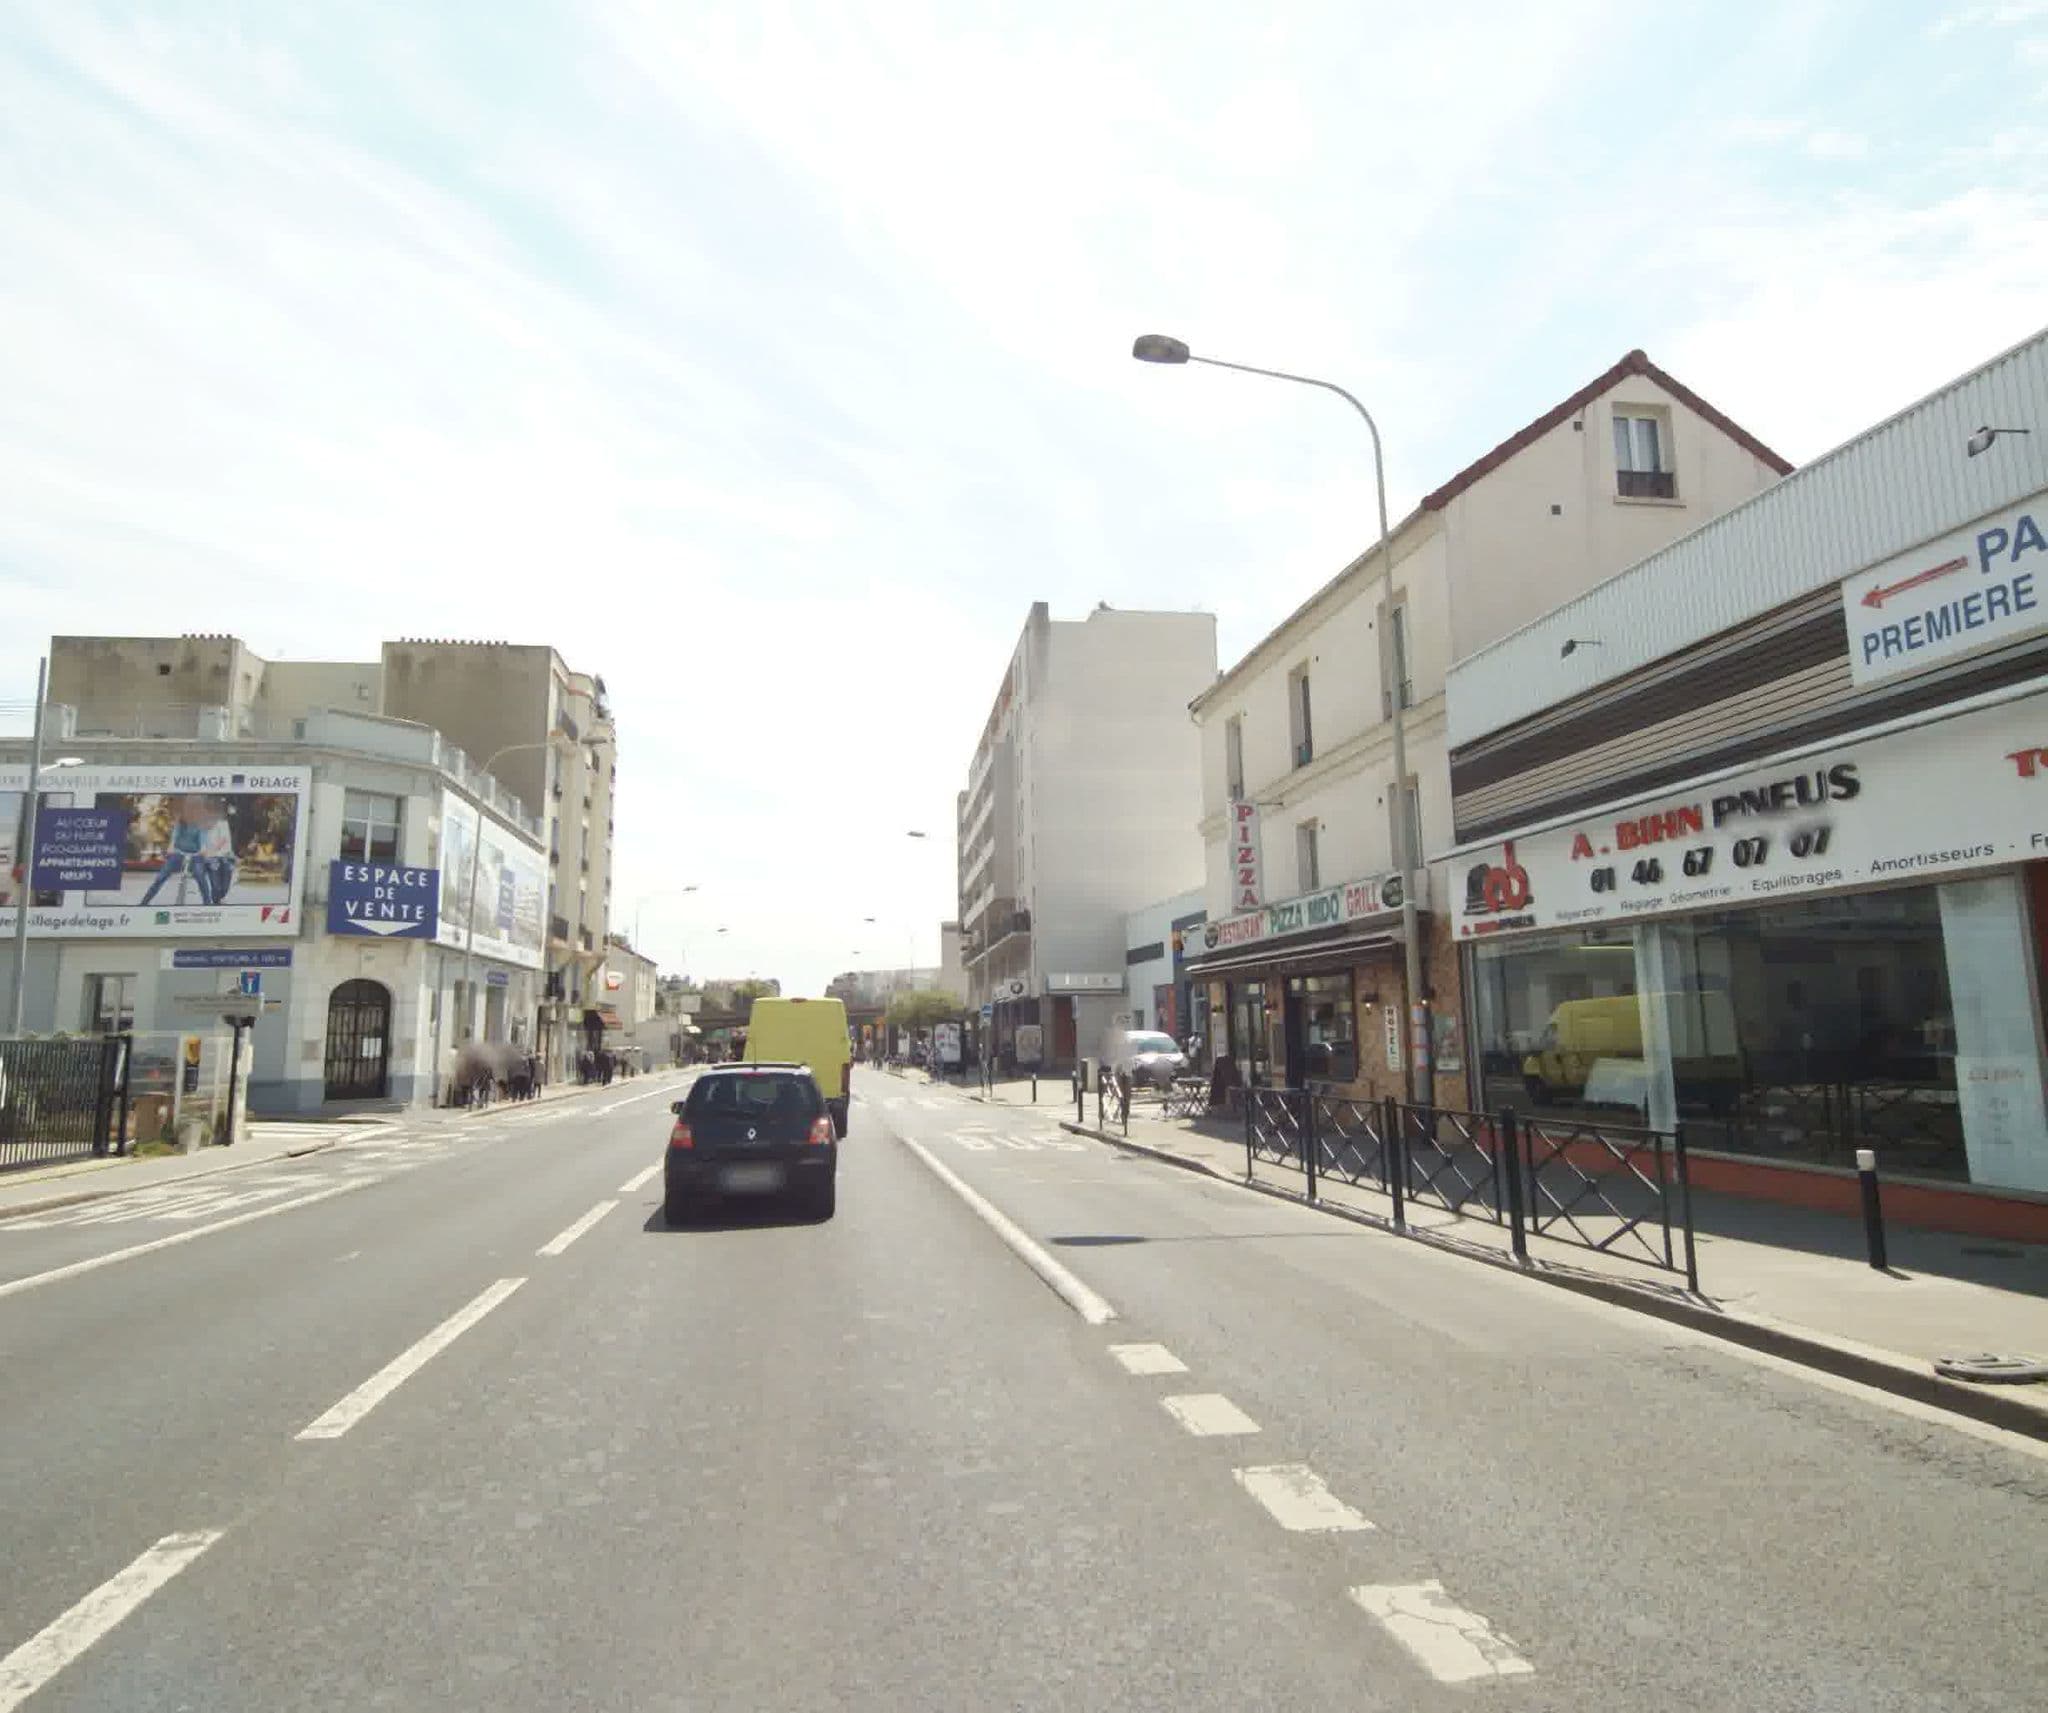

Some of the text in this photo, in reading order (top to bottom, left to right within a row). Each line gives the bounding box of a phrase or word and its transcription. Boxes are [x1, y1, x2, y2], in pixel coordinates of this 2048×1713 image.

[1977, 514, 2048, 574] PA
[1862, 573, 2038, 665] PREMIERE
[2003, 747, 2048, 777] T
[173, 775, 225, 788] VILLAGE
[249, 775, 300, 788] DELAGE
[1614, 803, 1704, 851] BIHN
[1711, 763, 1861, 828] PNEUS
[39, 857, 117, 869] APPARTEMENTS
[1235, 804, 1259, 906] PIZZA
[1682, 846, 1714, 877] 67
[1870, 842, 1995, 875] Amortisseurs
[344, 865, 428, 887] ESPACE
[374, 886, 396, 901] DE
[1269, 903, 1305, 936] PIZZA
[1345, 880, 1380, 920] GRILL
[345, 900, 425, 921] VENTE
